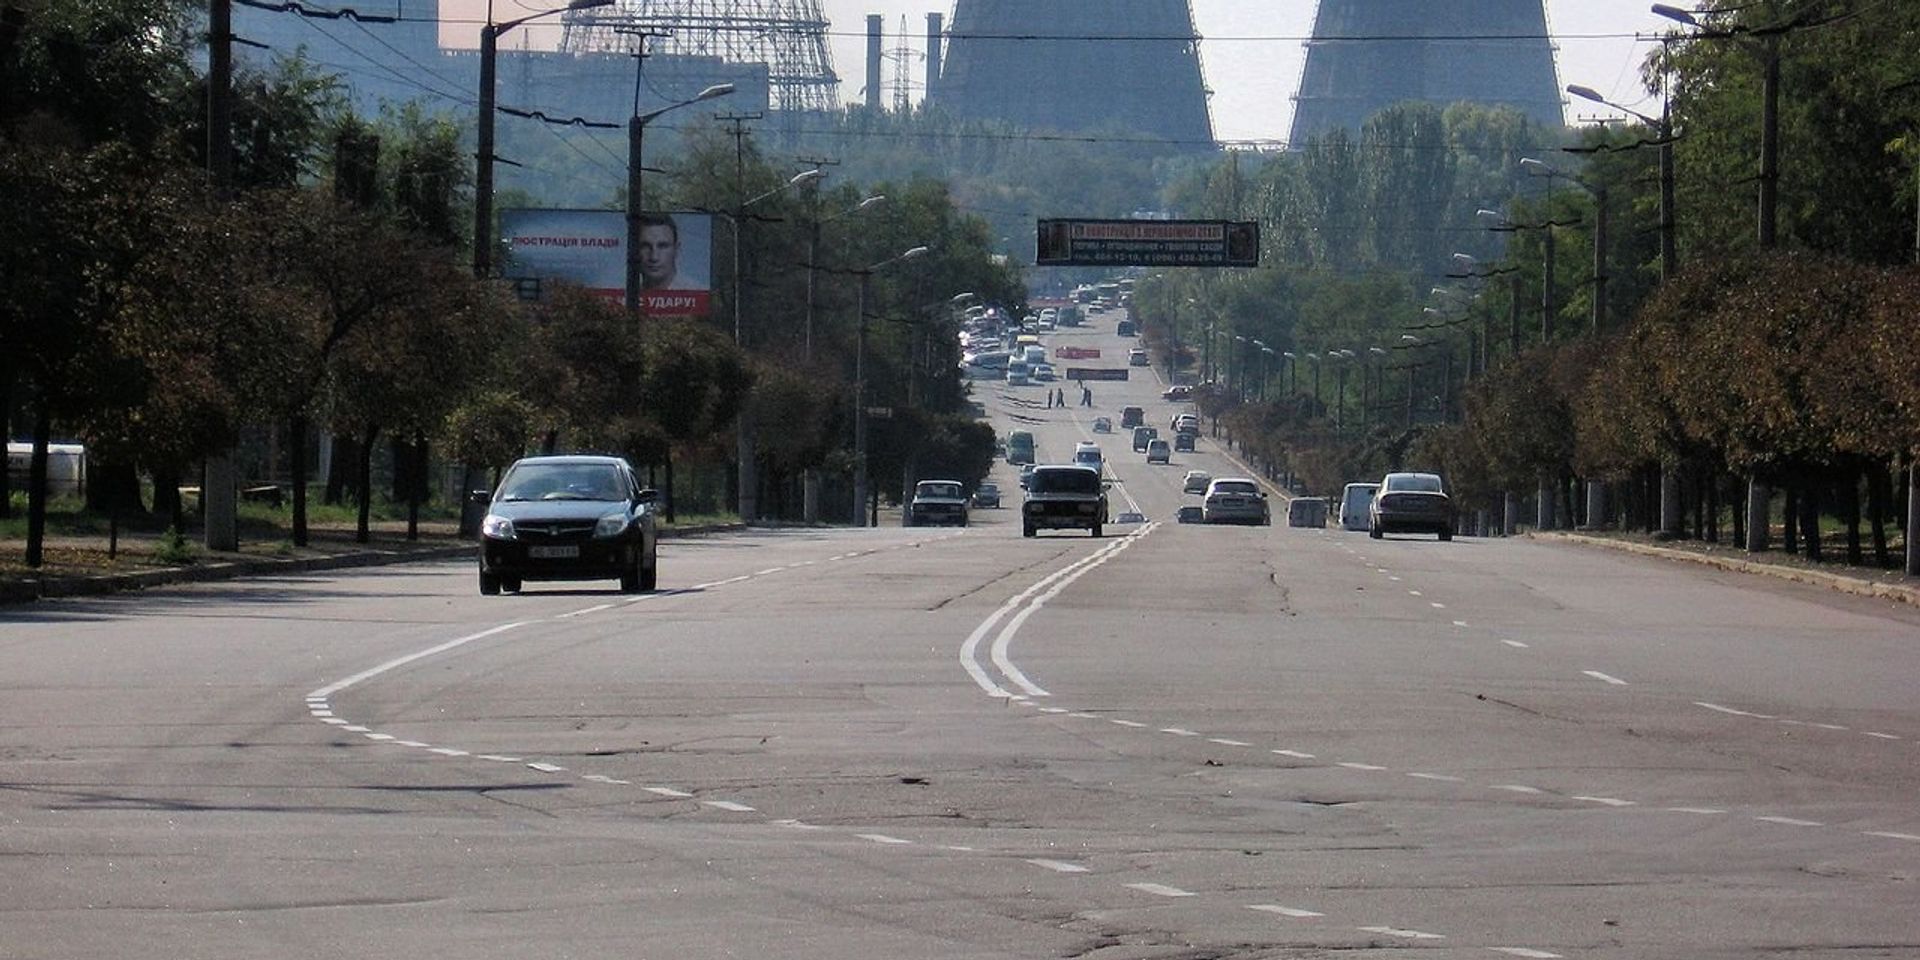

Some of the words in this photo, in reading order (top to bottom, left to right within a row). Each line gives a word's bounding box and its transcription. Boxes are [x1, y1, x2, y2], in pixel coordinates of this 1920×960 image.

[512, 237, 577, 248] ЛЮСТРАЦІЯ
[581, 238, 619, 248] ВЛАДИ
[648, 297, 696, 308] УДАРУ!
